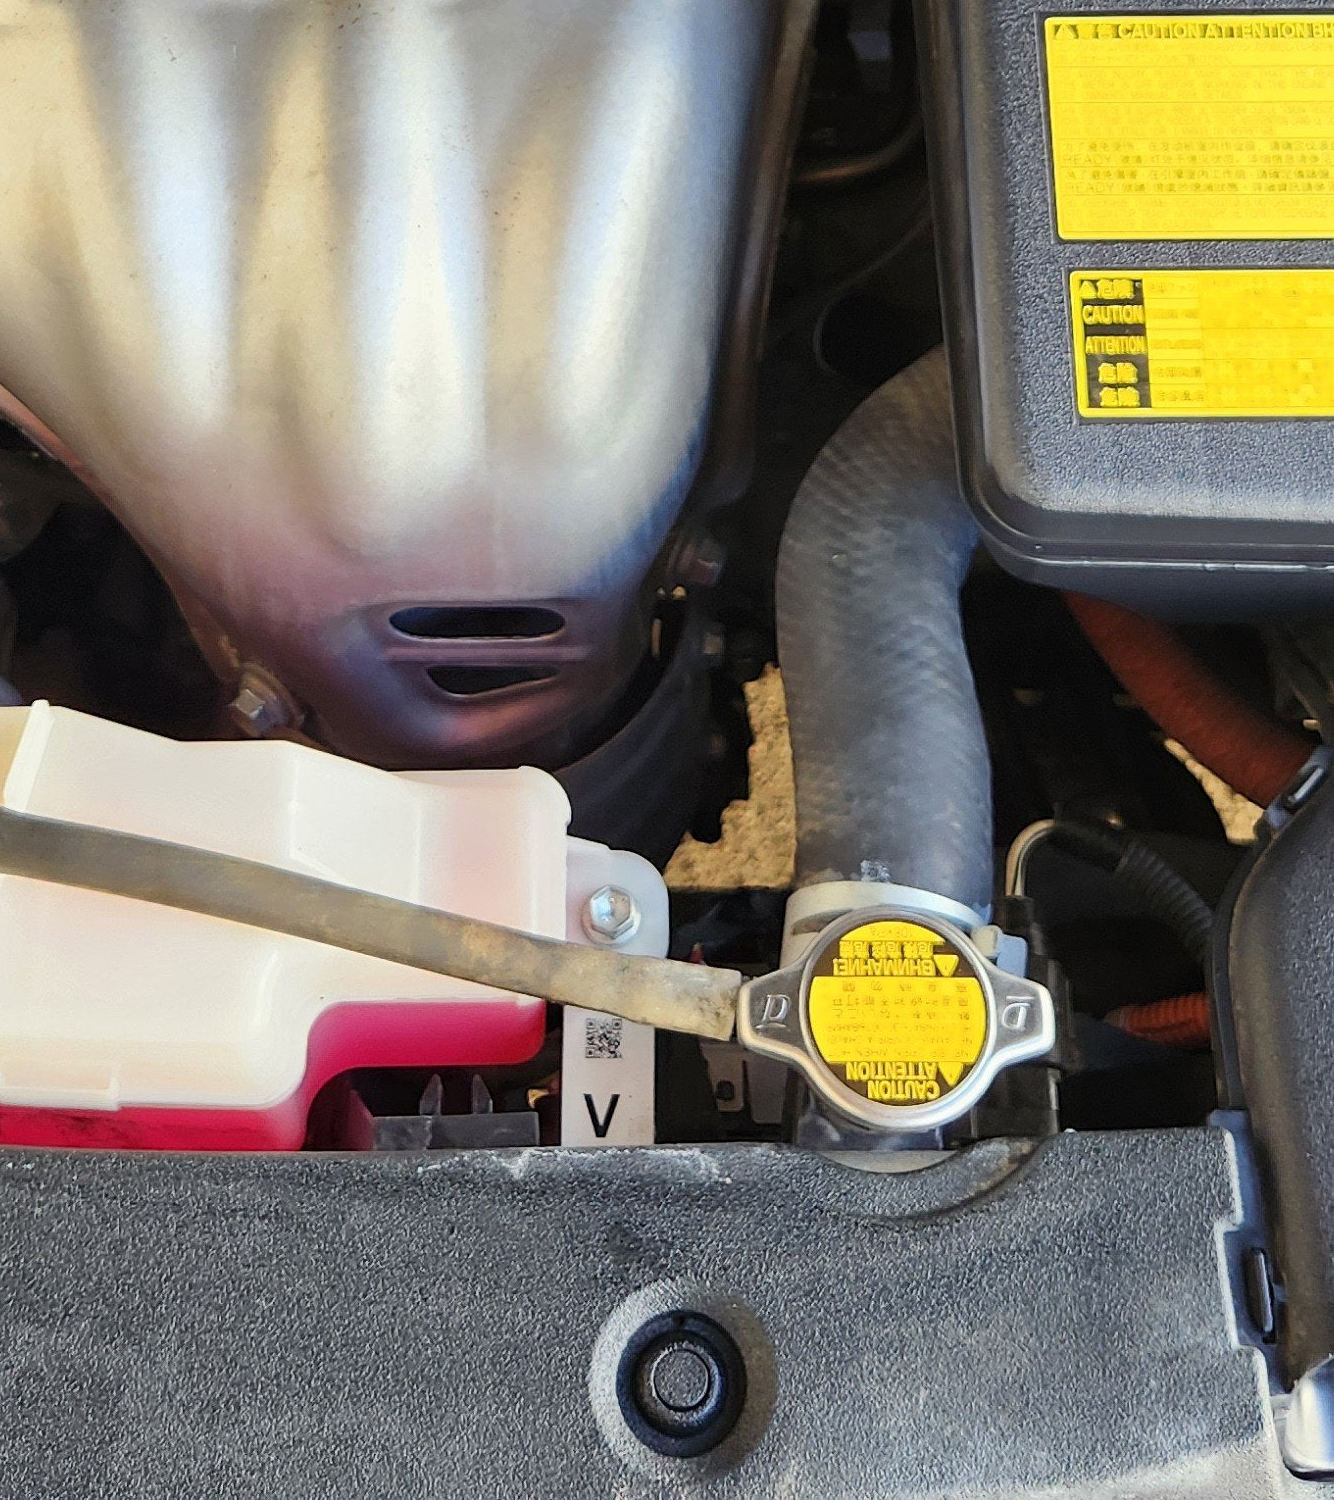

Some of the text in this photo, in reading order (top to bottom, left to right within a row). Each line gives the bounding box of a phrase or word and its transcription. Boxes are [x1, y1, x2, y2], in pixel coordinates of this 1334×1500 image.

[1118, 23, 1199, 40] CAUTION
[1203, 23, 1307, 40] ATTENTION
[1083, 304, 1144, 325] CAUTION
[1085, 336, 1147, 355] ATTENTION
[832, 958, 935, 976] ВНИМАНИЕ!
[845, 1061, 938, 1080] ATTENTION
[867, 1080, 941, 1100] CAUTION
[583, 1093, 621, 1138] V
